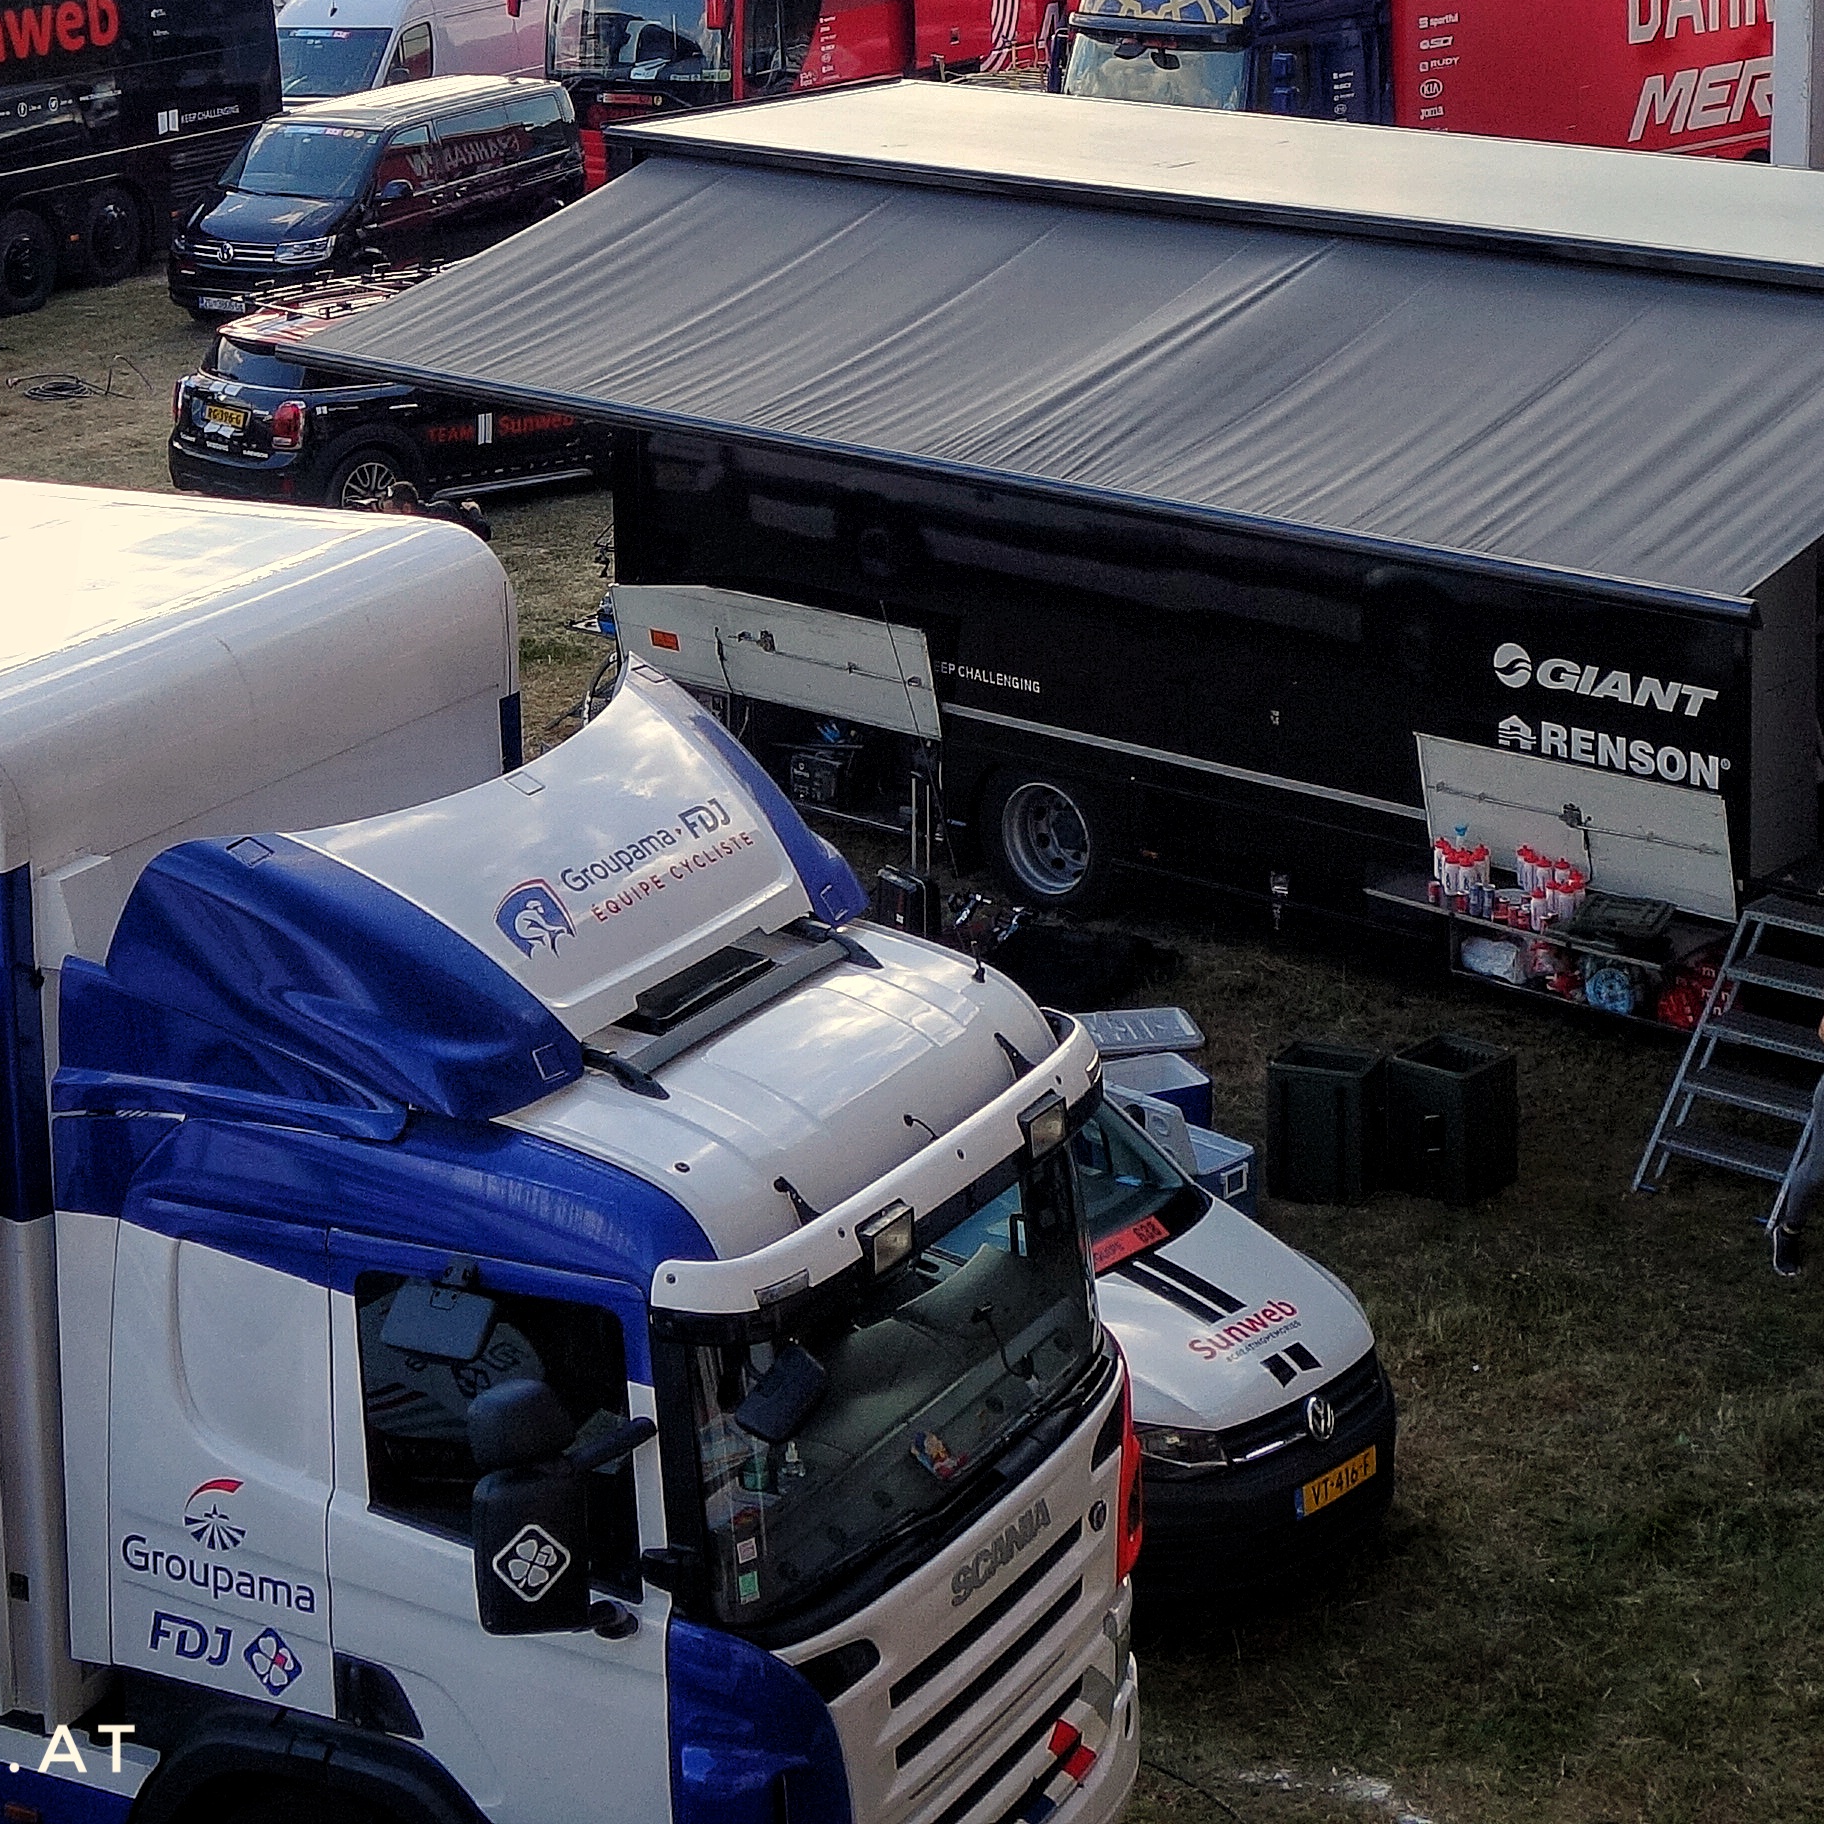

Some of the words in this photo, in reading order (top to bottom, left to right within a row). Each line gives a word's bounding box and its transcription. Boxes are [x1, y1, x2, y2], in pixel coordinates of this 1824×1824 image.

[958, 664, 1041, 694] CHALLENGING
[1536, 657, 1719, 717] GIANT
[560, 827, 678, 893] Groupama
[678, 797, 732, 841] FDJ
[590, 874, 666, 924] ÉQUIPE
[669, 830, 755, 882] CYCLISTE
[1187, 1298, 1299, 1361] Sunweb
[121, 1532, 318, 1614] Groupama
[951, 1497, 1053, 1608] SCANIA
[147, 1609, 233, 1668] FDJ
